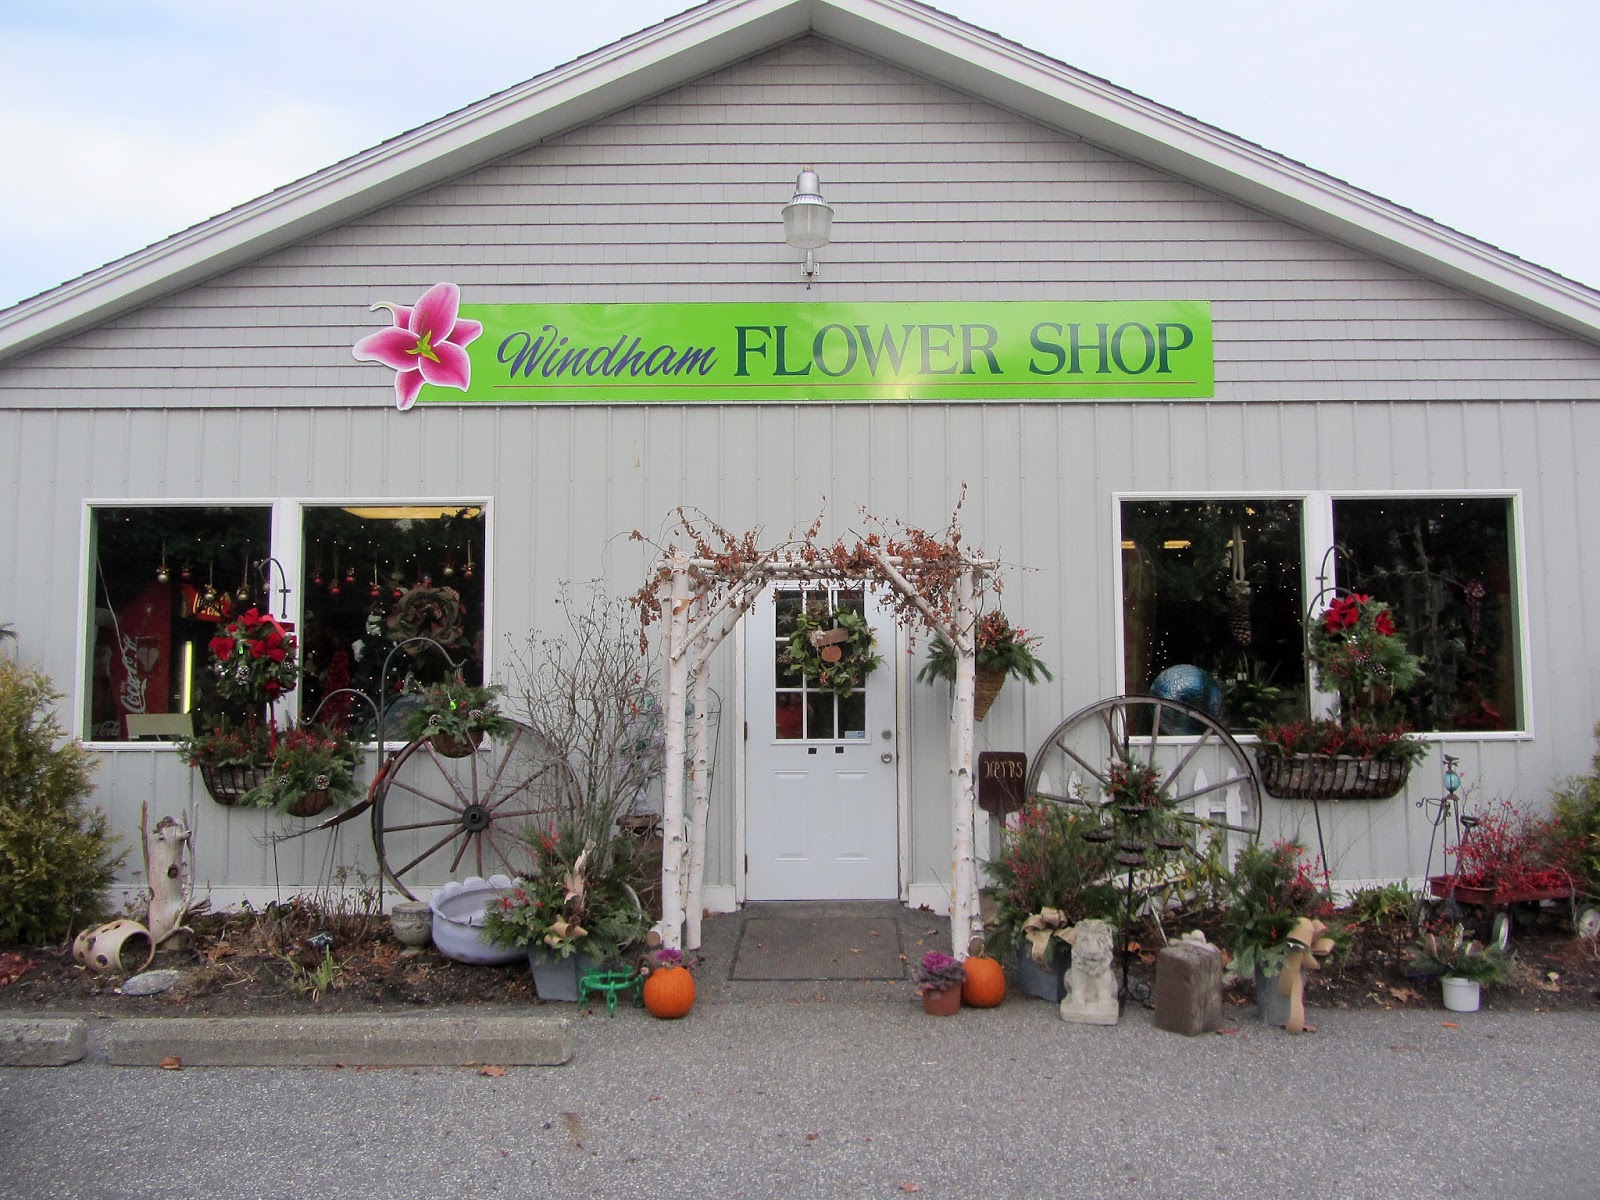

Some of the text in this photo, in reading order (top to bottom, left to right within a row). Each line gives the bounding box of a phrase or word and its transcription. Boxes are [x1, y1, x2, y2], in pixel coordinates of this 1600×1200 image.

[496, 322, 1194, 379] Windham FLOWER SHOP
